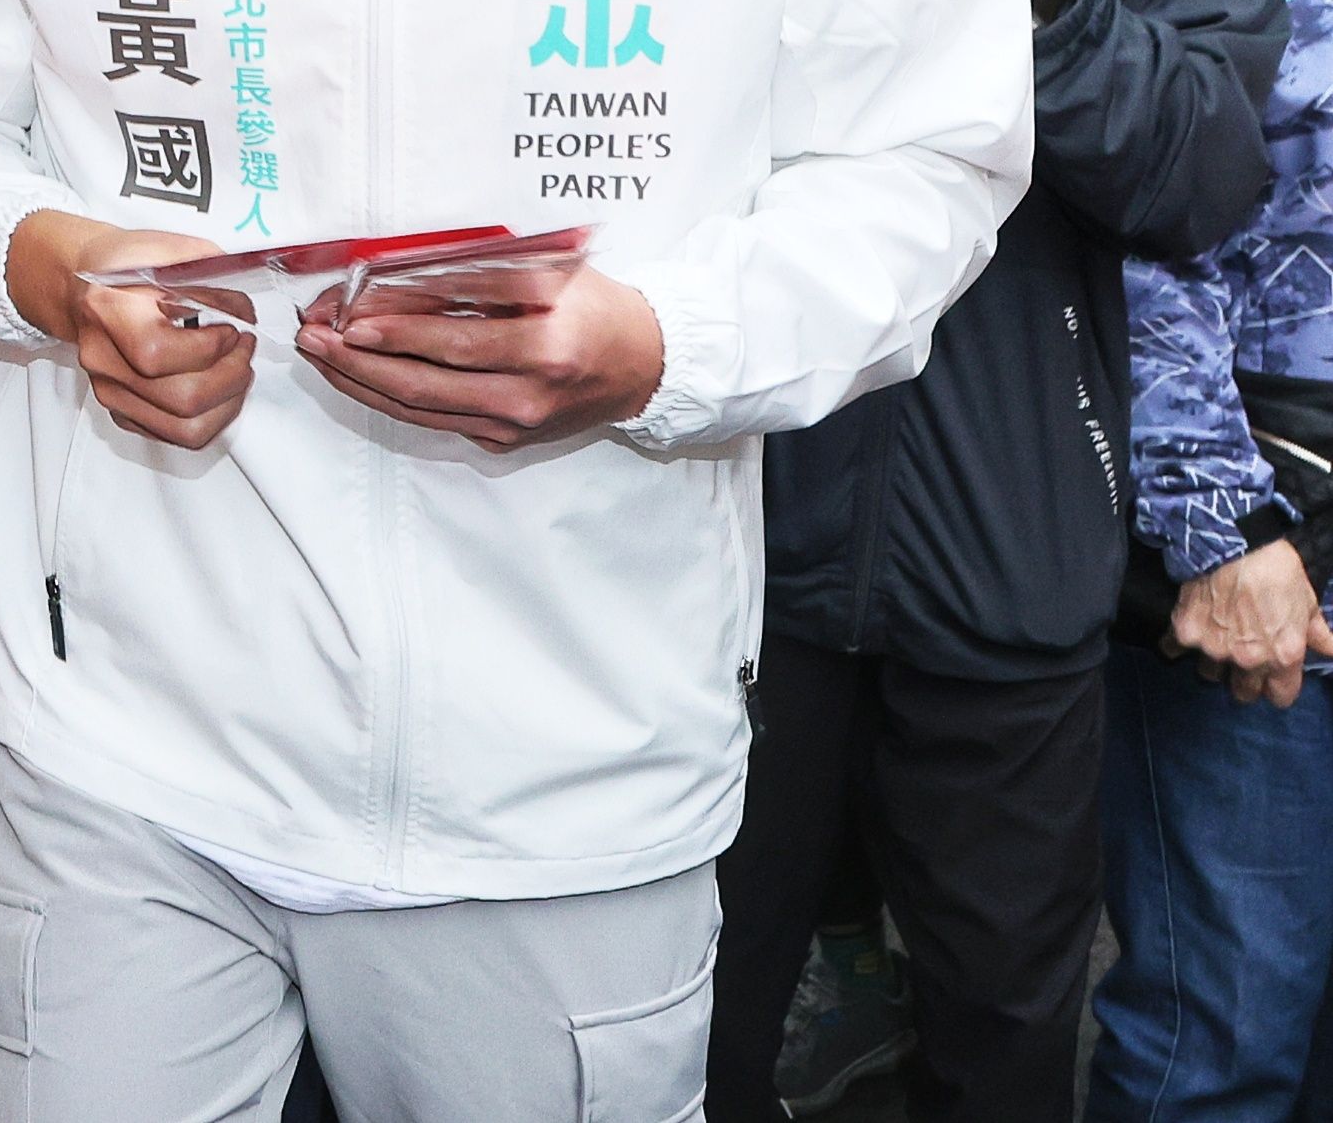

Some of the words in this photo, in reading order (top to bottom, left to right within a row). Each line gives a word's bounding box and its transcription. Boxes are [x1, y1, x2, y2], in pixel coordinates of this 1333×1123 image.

[522, 90, 668, 119] TAIWAN
[512, 131, 673, 160] PEOPLE'S
[538, 172, 653, 201] PARTY
